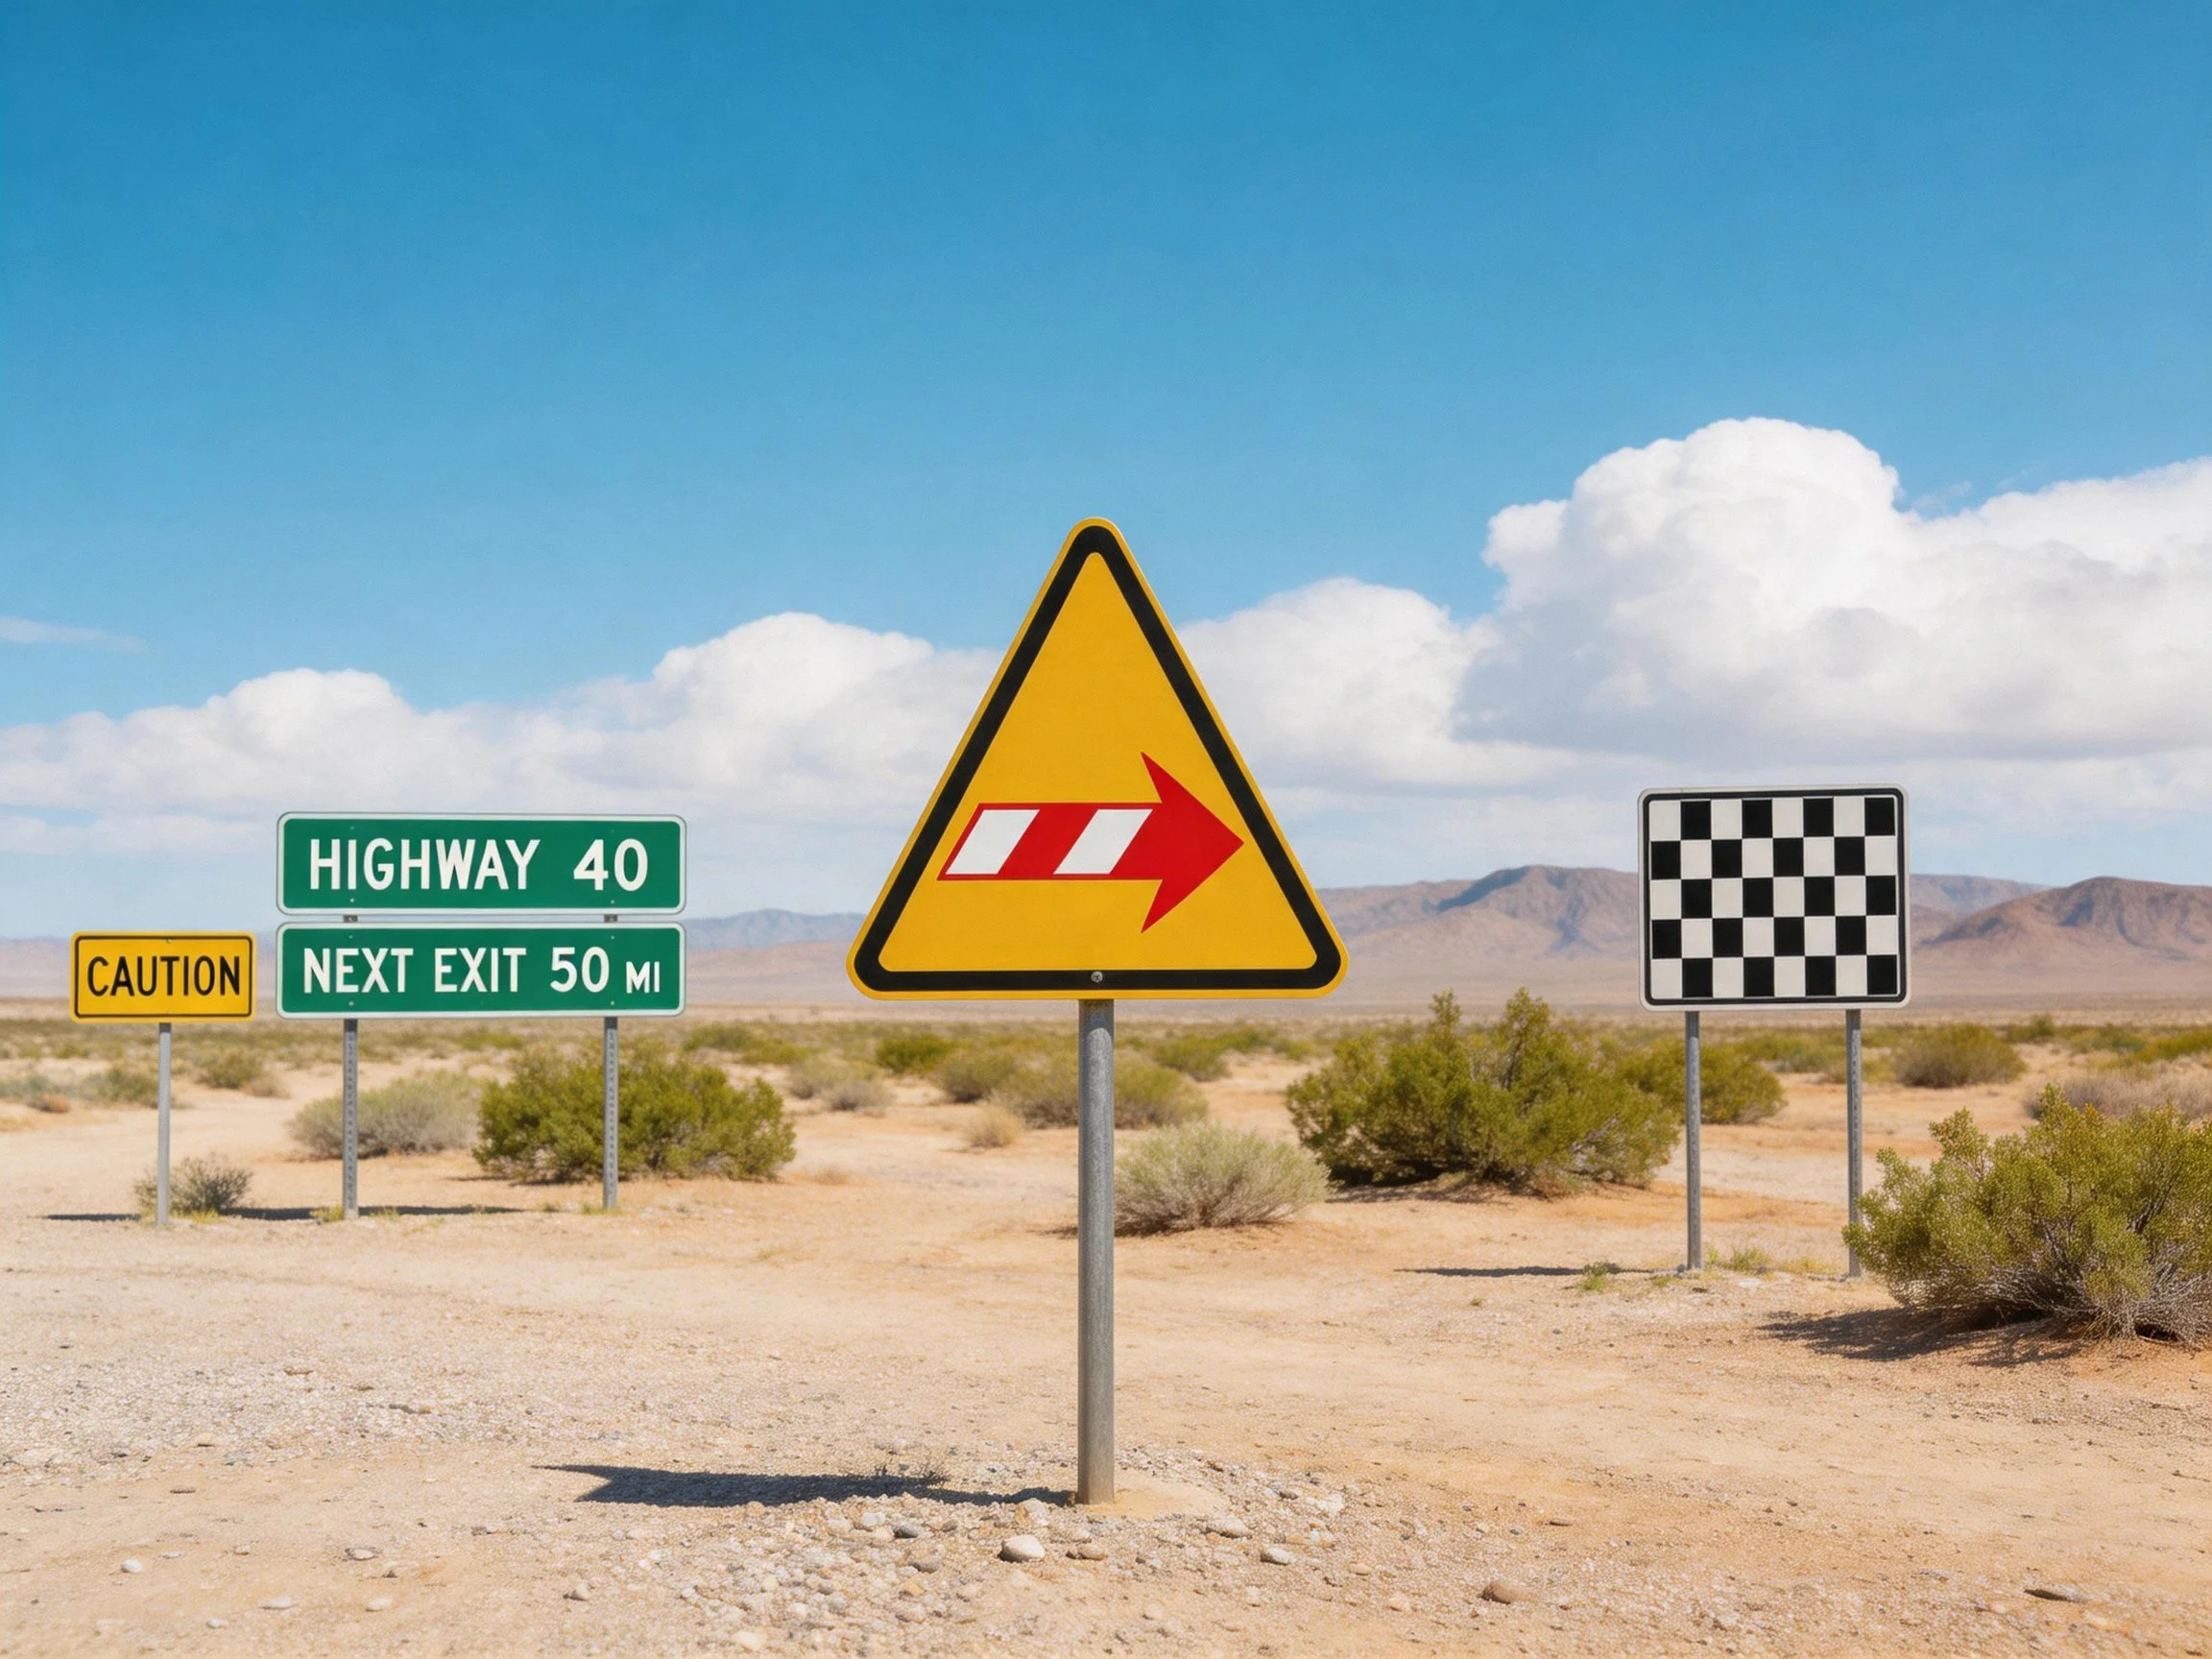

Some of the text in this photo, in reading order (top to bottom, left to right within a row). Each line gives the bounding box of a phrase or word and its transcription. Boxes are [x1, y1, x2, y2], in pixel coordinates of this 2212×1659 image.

[310, 838, 649, 891] HIGHWAY 40
[87, 955, 240, 997] CAUTION
[303, 947, 661, 994] NEXT EXIT 50 MI
